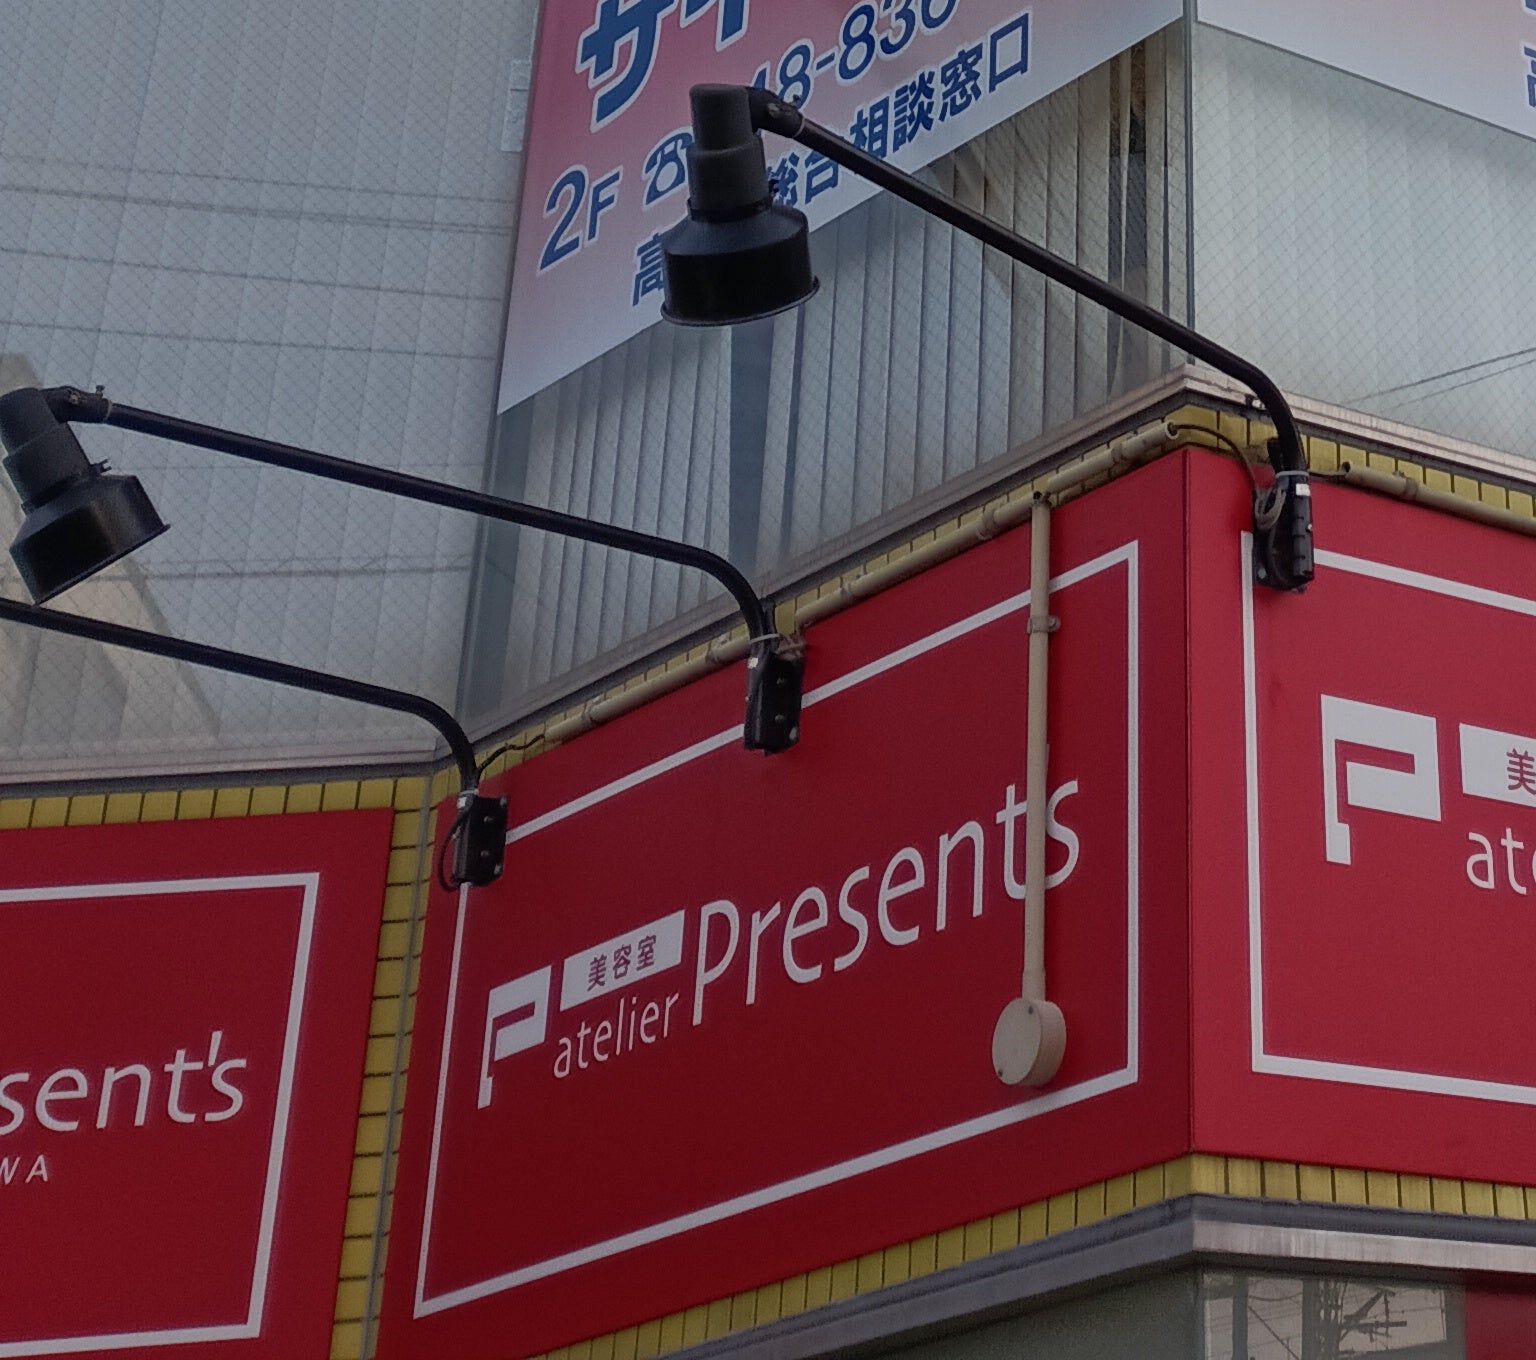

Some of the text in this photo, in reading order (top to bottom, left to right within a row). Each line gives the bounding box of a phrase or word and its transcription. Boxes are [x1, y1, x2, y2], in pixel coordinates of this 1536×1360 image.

[538, 163, 622, 273] 2F
[587, 935, 657, 993] 美容室
[553, 991, 680, 1080] atelier
